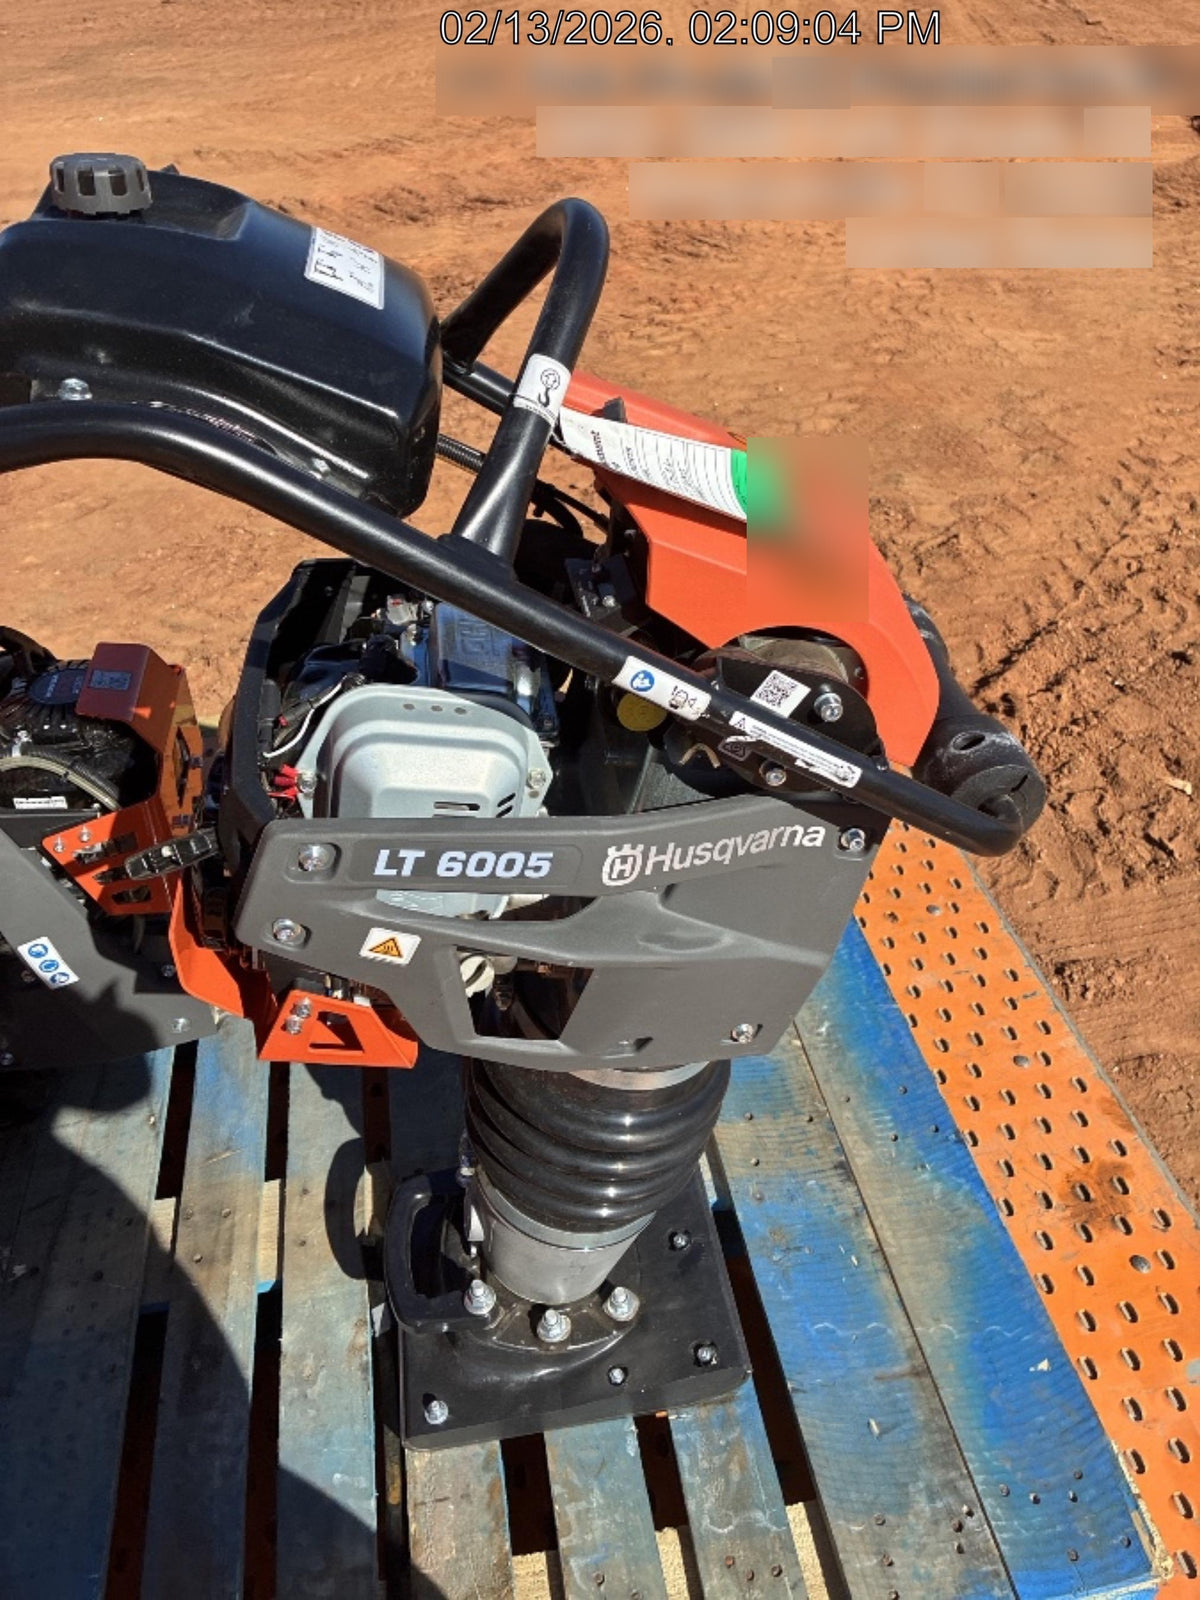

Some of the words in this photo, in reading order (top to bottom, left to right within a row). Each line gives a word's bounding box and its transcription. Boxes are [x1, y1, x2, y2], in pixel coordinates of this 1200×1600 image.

[373, 849, 426, 877] LT
[436, 850, 554, 879] 6005
[644, 824, 827, 876] Husqvarna
